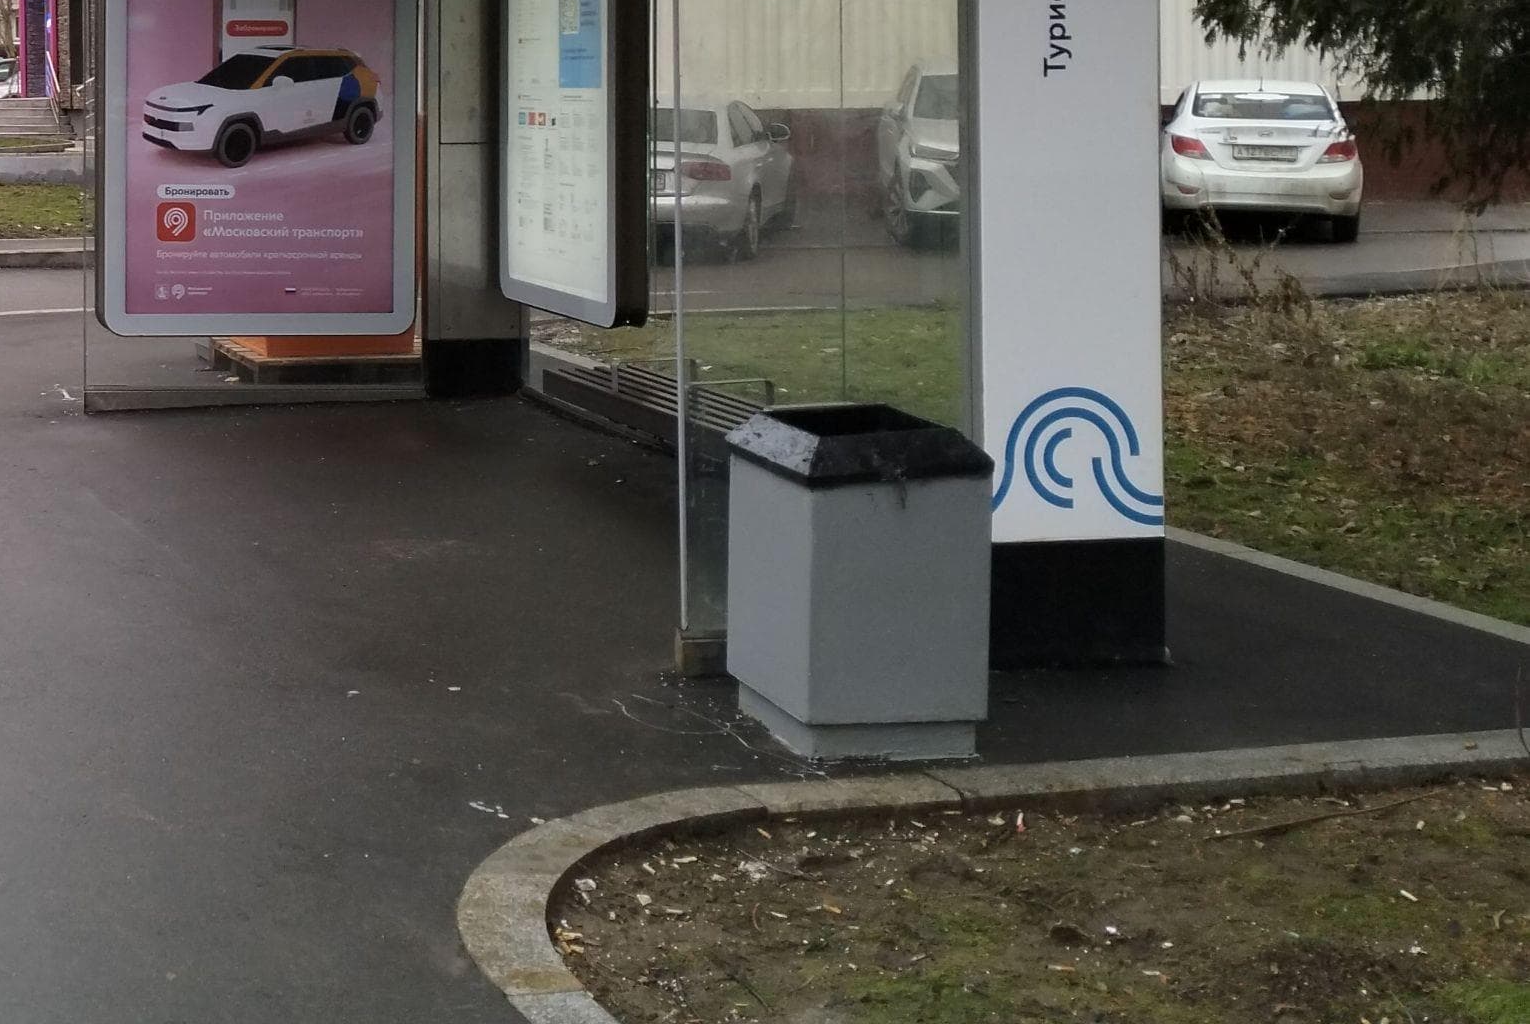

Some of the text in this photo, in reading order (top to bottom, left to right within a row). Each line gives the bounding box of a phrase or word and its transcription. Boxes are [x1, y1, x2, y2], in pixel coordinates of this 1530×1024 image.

[164, 186, 230, 197] Бронировать
[203, 209, 284, 223] Приложение
[202, 227, 363, 240] «Московский транспорт»
